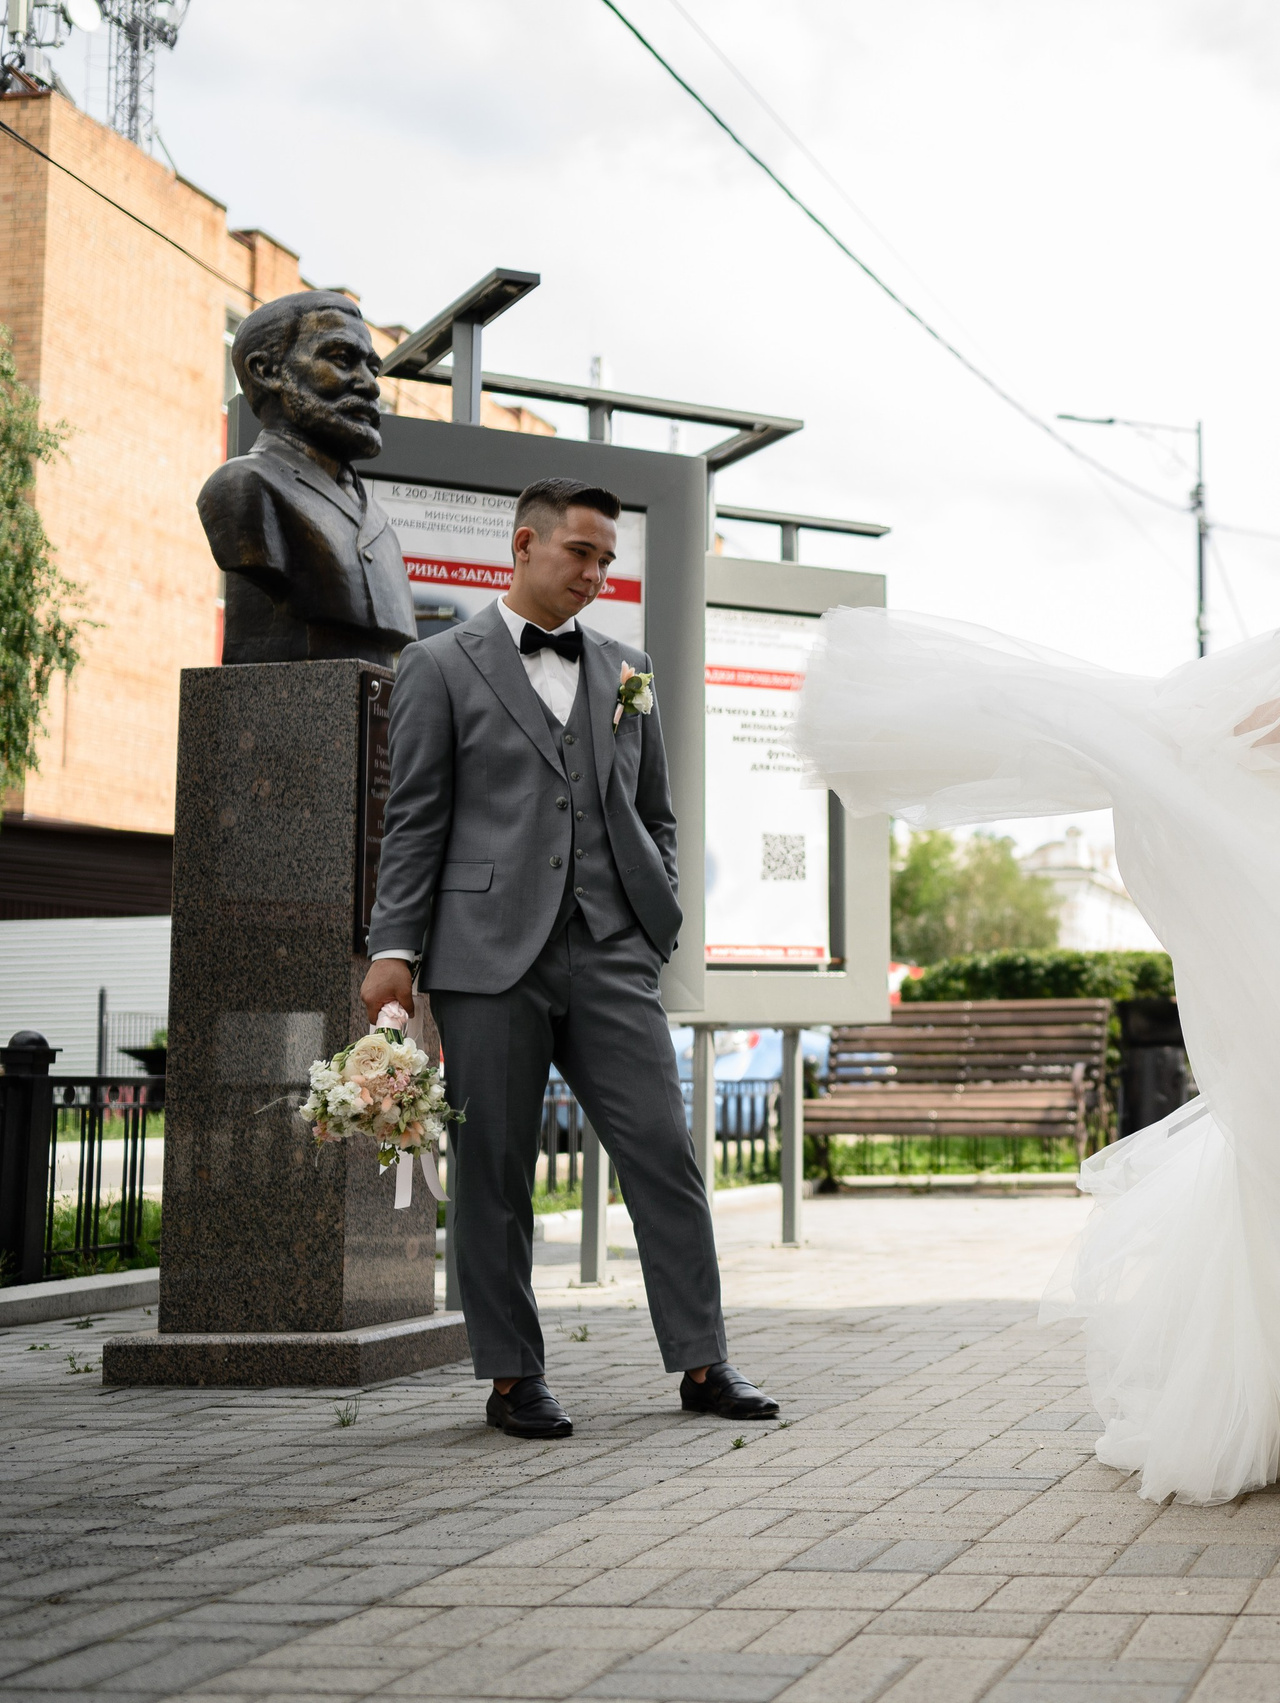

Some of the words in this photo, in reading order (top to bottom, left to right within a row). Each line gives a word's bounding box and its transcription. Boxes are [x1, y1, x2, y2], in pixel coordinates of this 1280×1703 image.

[391, 484, 400, 497] К
[424, 509, 504, 527] МИНУСИНСКИЙ
[476, 527, 509, 539] МУЗЕЙ
